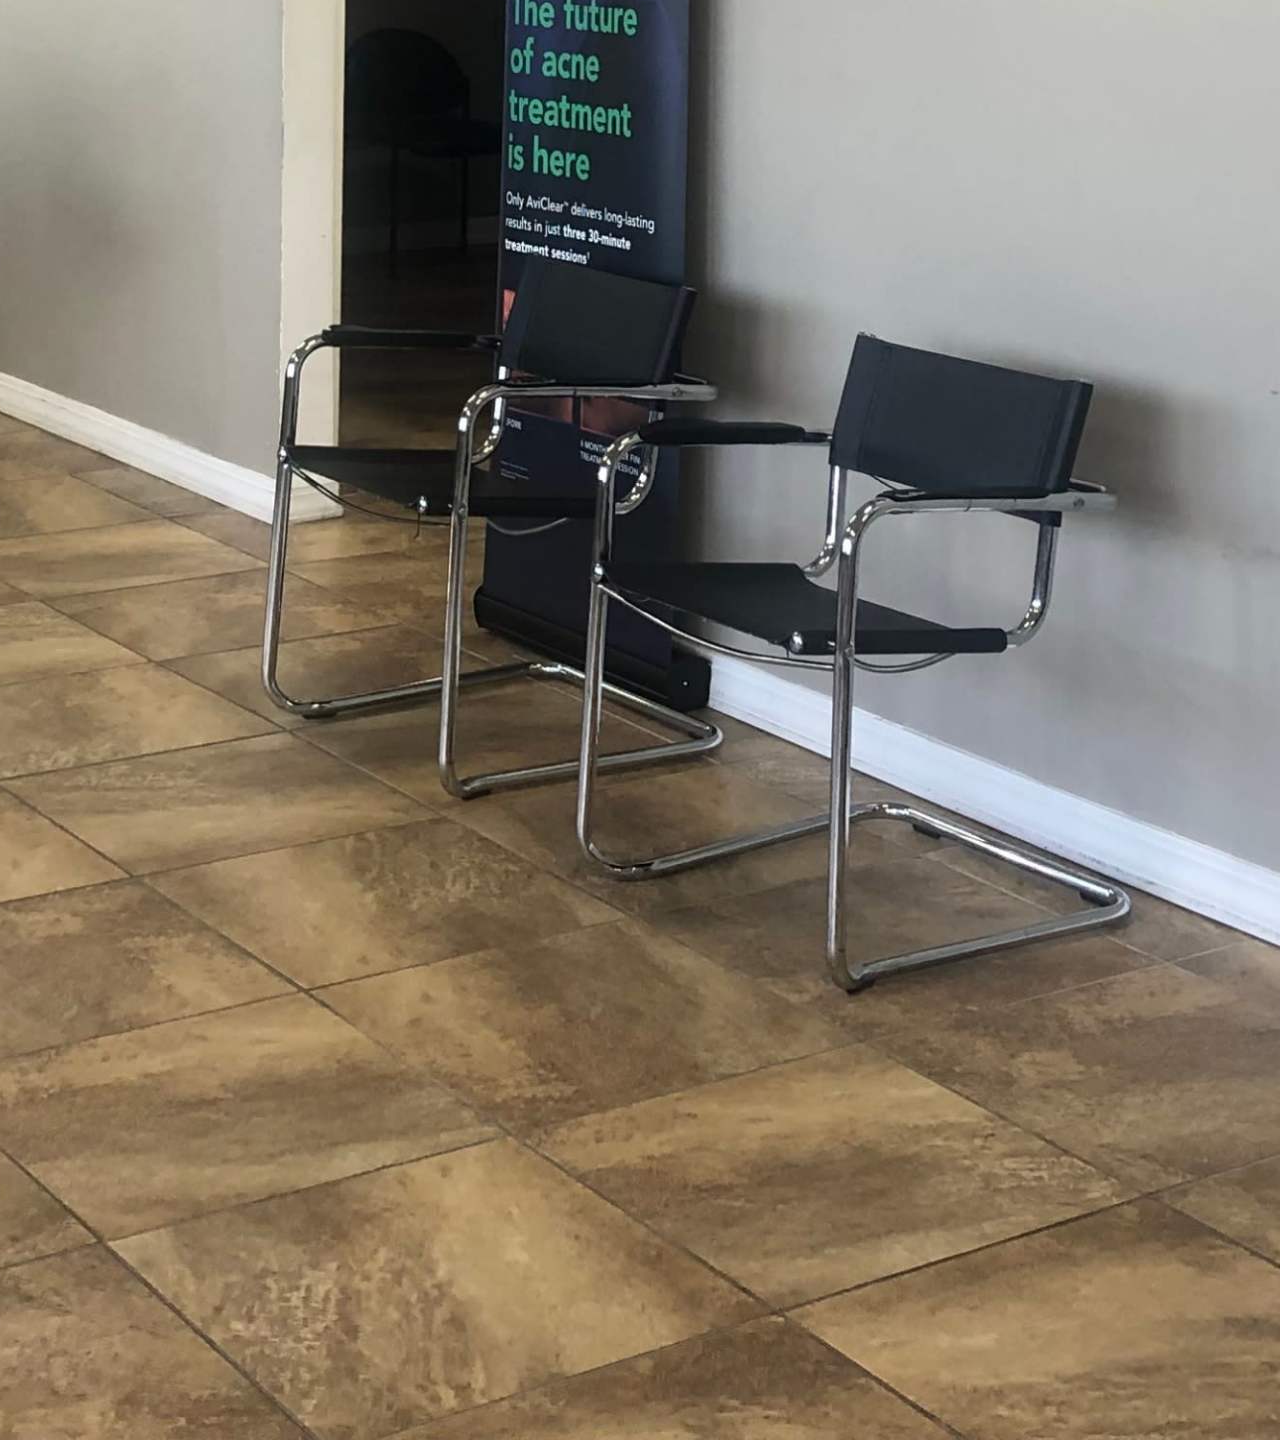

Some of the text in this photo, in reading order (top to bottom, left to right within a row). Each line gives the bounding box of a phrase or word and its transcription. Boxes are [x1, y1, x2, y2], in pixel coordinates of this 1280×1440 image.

[510, 36, 599, 82] of acne
[509, 89, 632, 137] treatment
[508, 133, 590, 180] is here
[505, 216, 631, 250] results in just three 30-minute
[506, 191, 524, 208] Only
[571, 202, 603, 221] delivers
[604, 208, 655, 234] long-lasting
[505, 238, 549, 257] treatment
